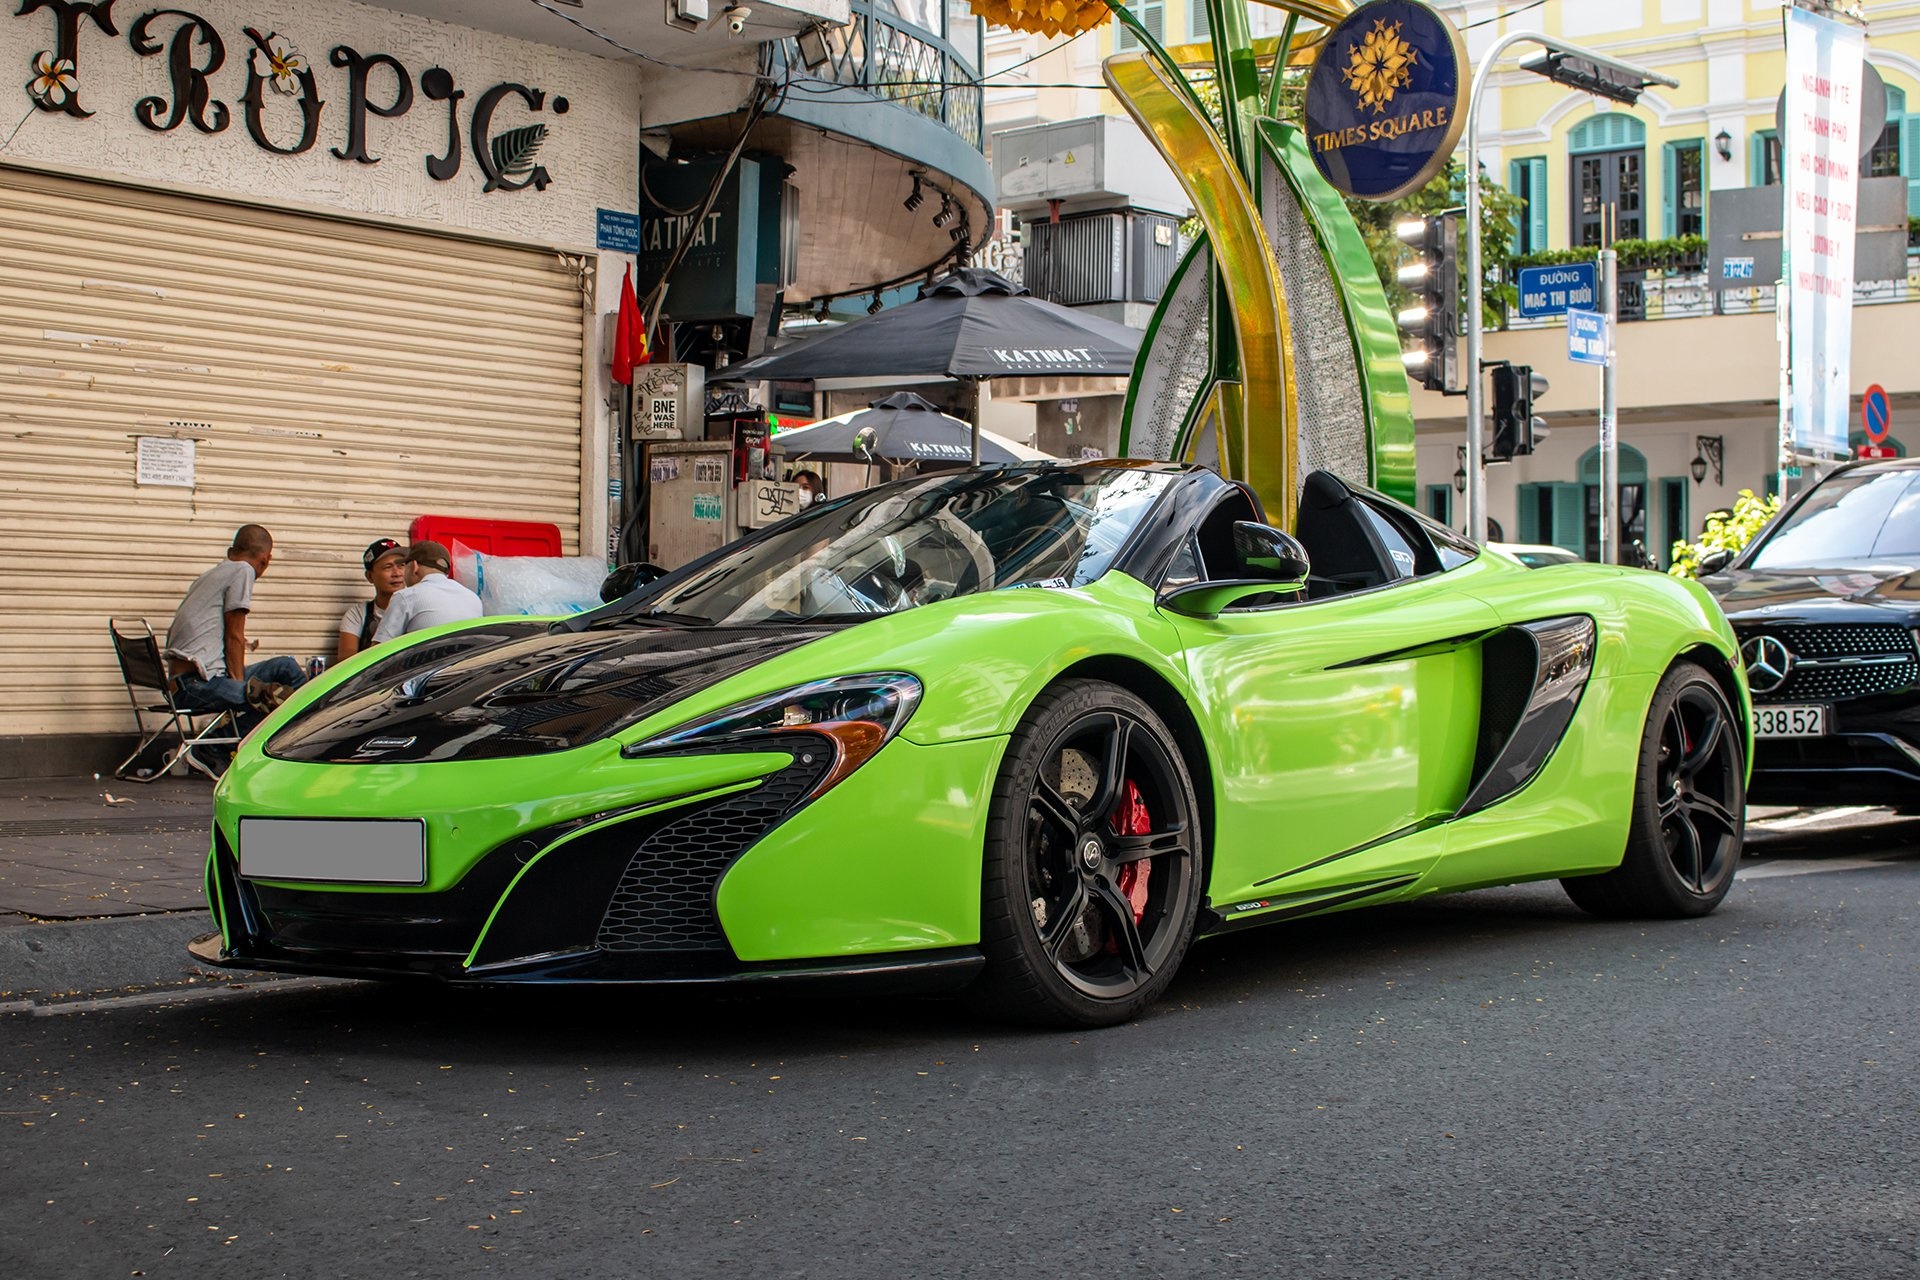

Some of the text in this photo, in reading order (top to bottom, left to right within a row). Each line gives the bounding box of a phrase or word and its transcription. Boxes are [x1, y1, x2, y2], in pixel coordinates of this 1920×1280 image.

[1313, 106, 1448, 153] TIMES SQUARE
[1814, 154, 1826, 176] CHÍ
[1828, 160, 1848, 181] MINH
[1814, 195, 1828, 216] CAO
[1539, 271, 1580, 286] ĐƯỜNG
[1524, 282, 1592, 311] MẠC THỊ BƯỞI
[993, 348, 1092, 362] KATINAT
[653, 400, 675, 414] BNE
[653, 421, 675, 429] HERE
[1034, 698, 1077, 749] MICHELIN
